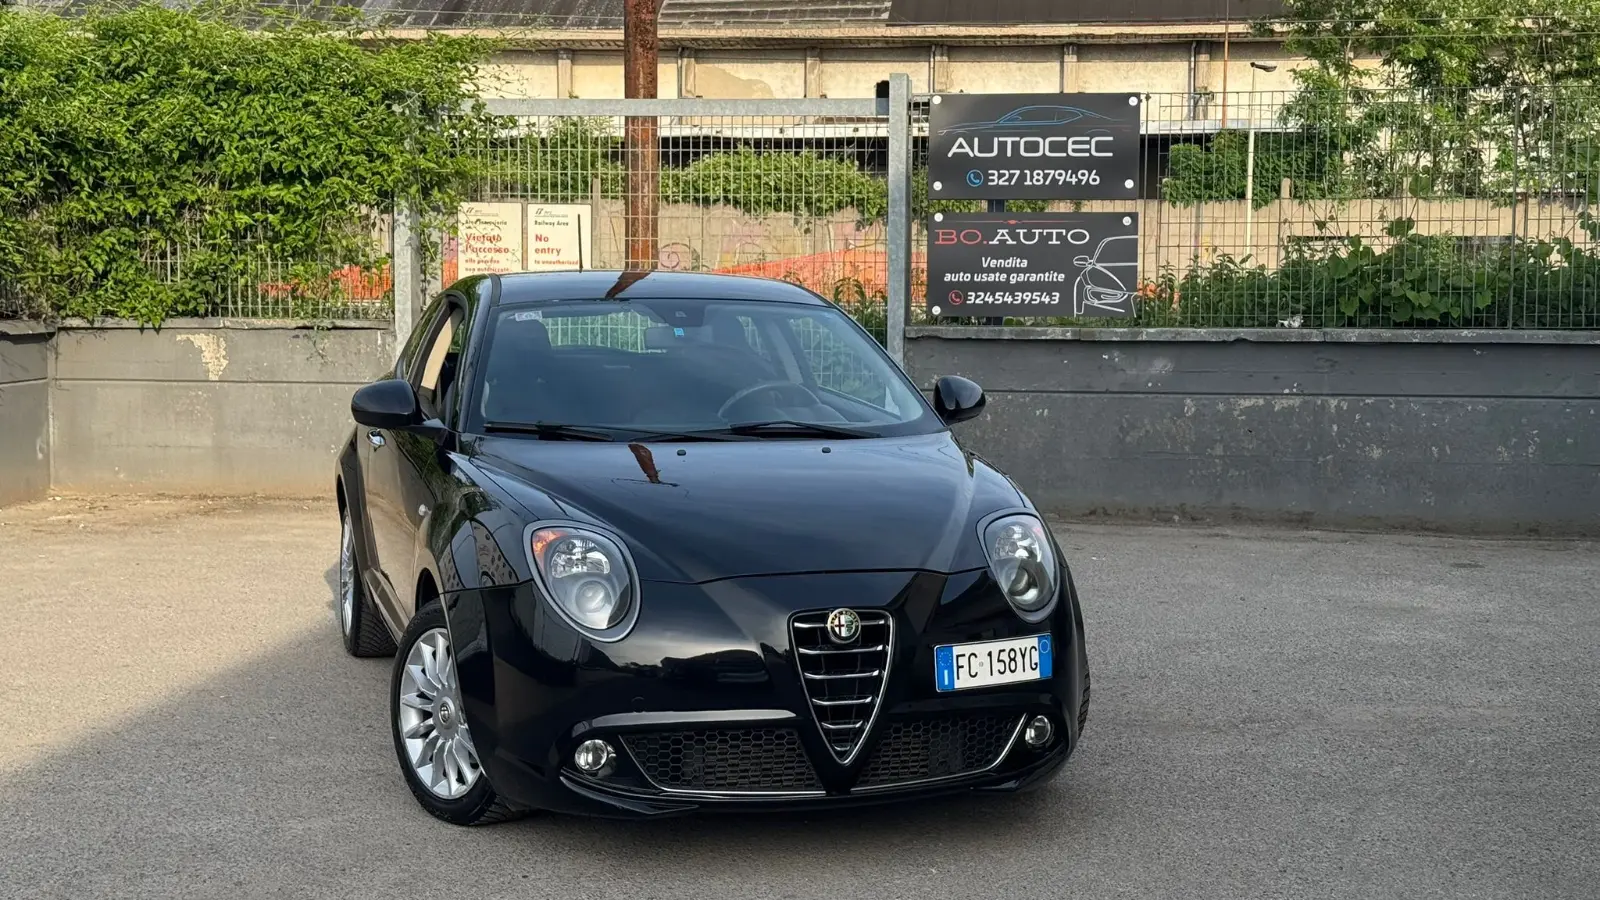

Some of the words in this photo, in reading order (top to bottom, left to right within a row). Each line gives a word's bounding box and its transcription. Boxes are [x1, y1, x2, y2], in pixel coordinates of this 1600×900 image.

[947, 136, 1114, 158] AUTOCEC
[987, 169, 1020, 186] 327
[1023, 169, 1100, 186] 1879496
[535, 233, 549, 243] No
[934, 228, 1090, 245] BO.AUTO
[534, 247, 562, 256] entry
[981, 256, 1028, 268] Vendita
[944, 272, 971, 282] auto
[973, 272, 1007, 282] usate
[1009, 271, 1065, 284] garantite
[966, 291, 1060, 305] 3245439543
[955, 652, 979, 680] FC
[986, 645, 1039, 677] 158YG
